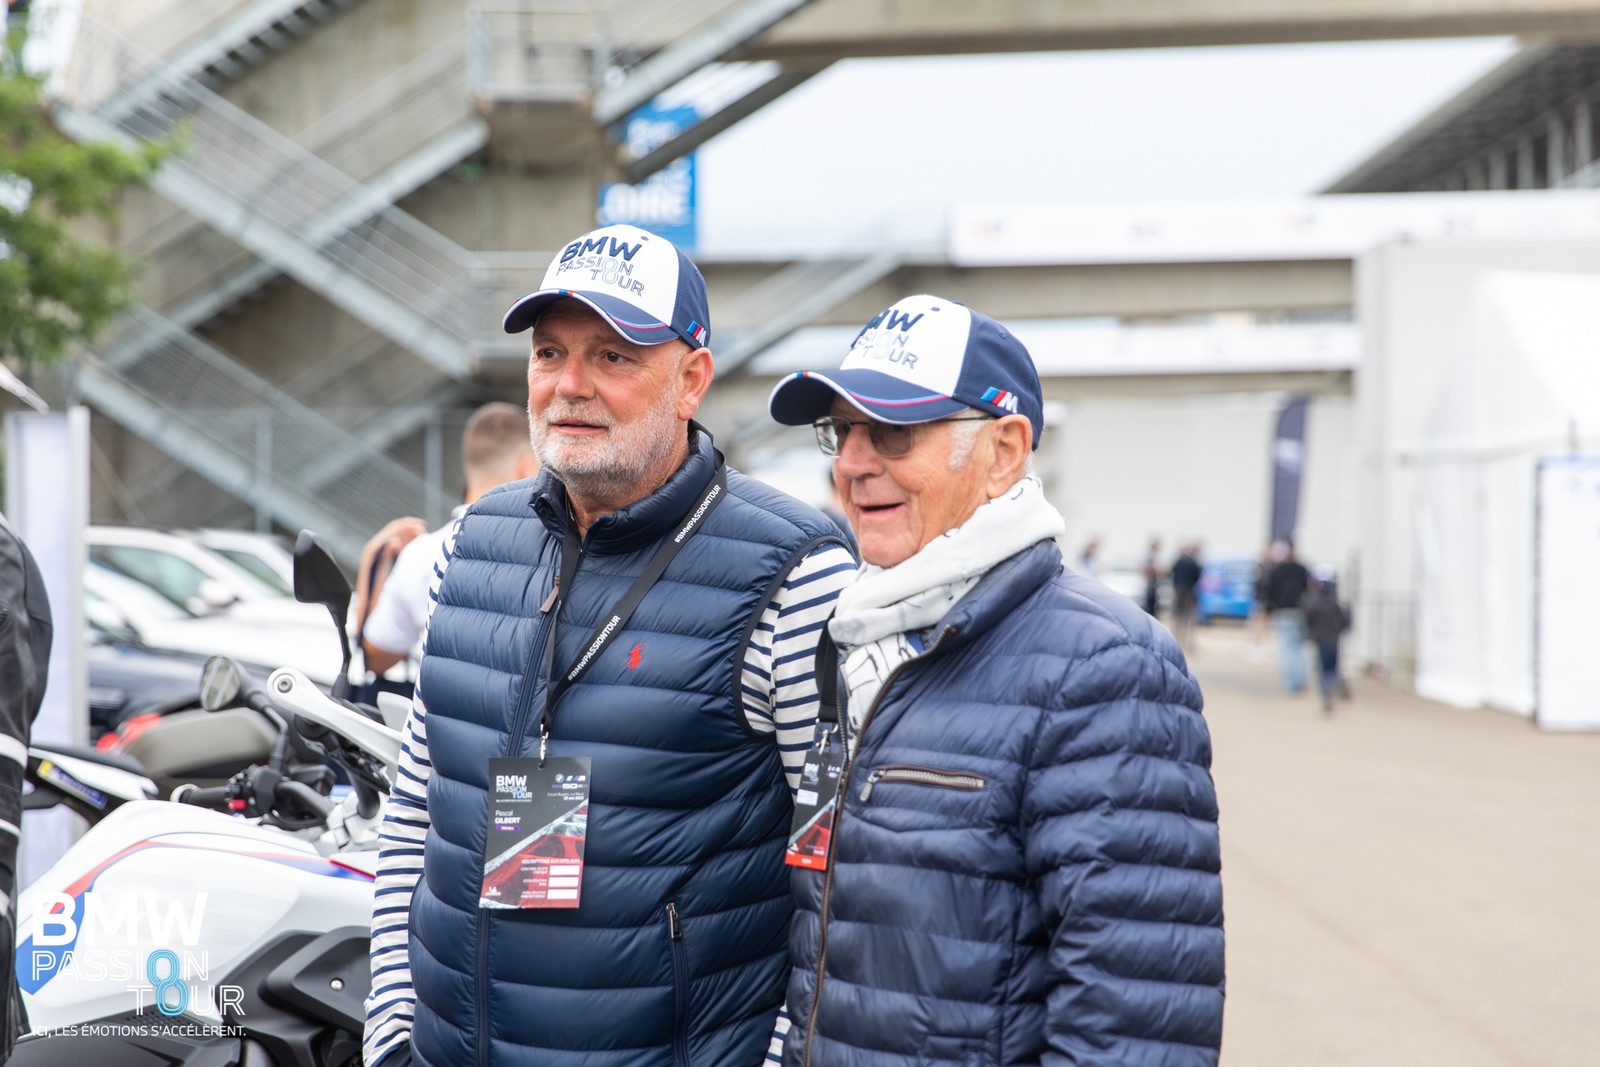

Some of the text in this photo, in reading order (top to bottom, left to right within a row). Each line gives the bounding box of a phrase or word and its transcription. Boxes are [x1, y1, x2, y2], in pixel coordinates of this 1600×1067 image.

[560, 236, 642, 264] BMW
[556, 256, 634, 276] PASSION
[590, 267, 645, 297] TOUR
[862, 344, 919, 370] TOUR
[674, 484, 722, 543] #BMWPASSIONTOUR
[567, 615, 621, 681] #BMWPASSIONTOUR
[496, 775, 527, 785] BMW
